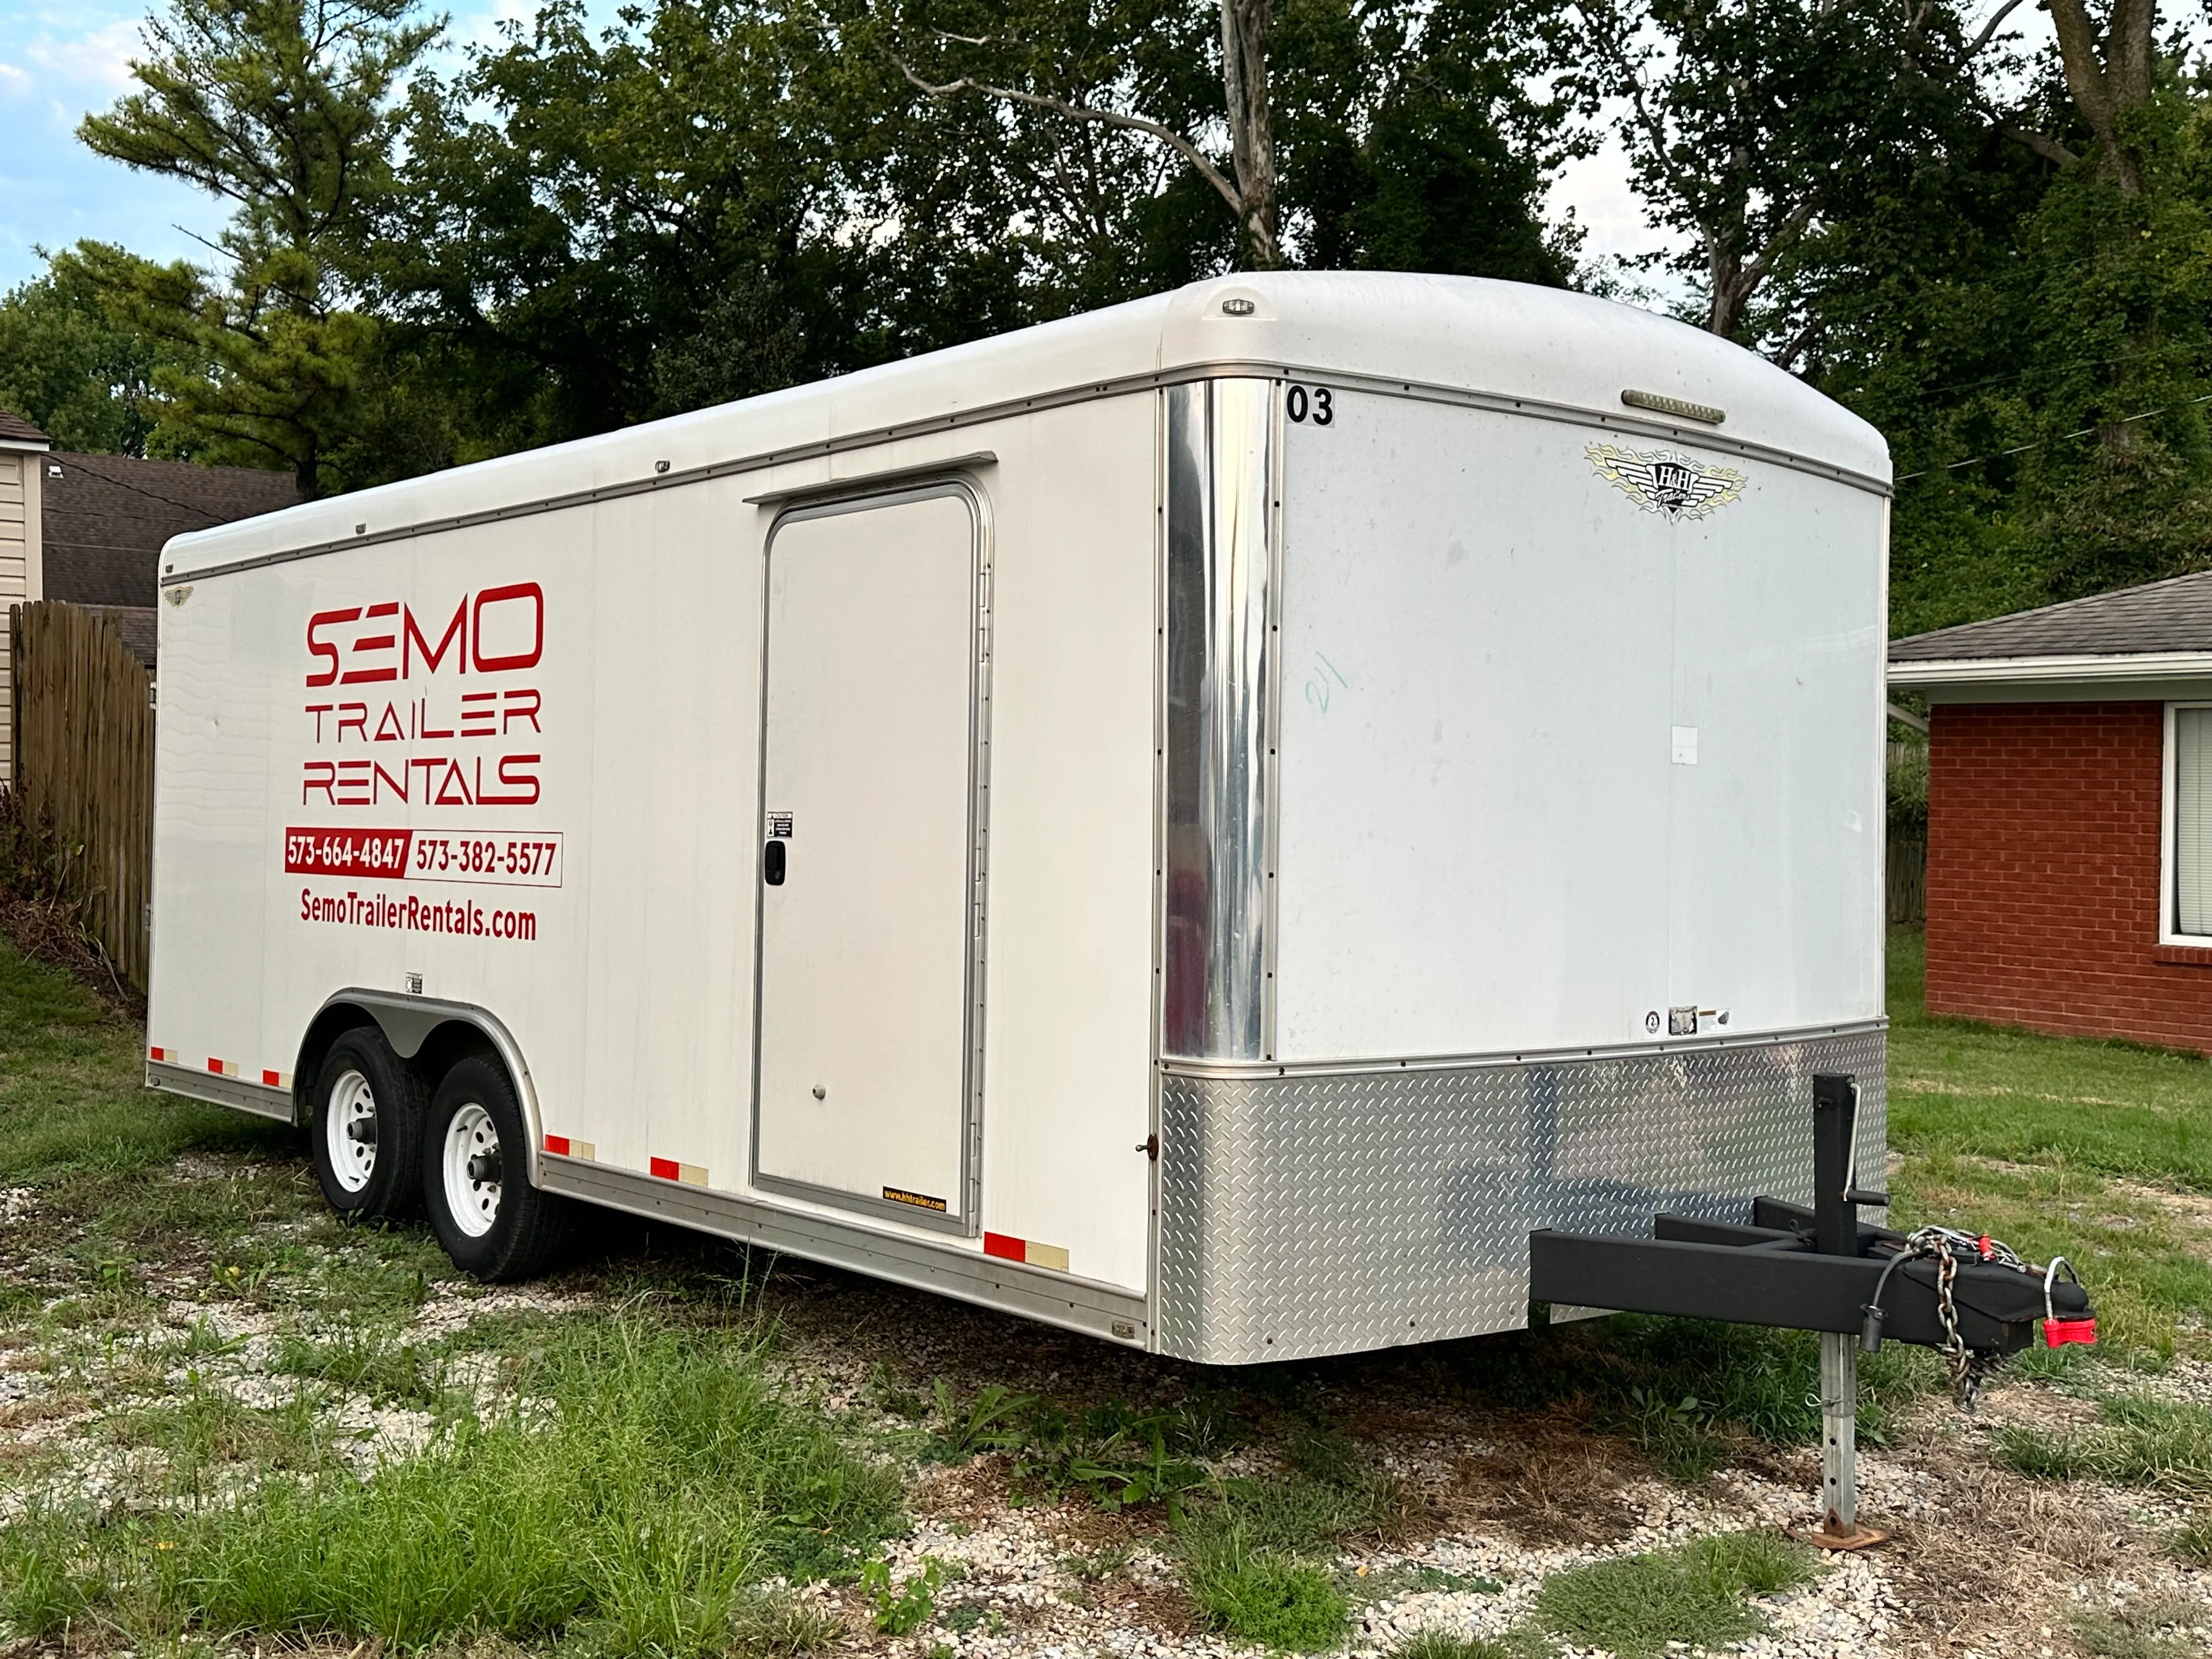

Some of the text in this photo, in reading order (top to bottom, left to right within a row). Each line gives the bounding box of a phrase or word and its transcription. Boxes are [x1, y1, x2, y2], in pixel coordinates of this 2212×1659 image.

[1286, 385, 1333, 426] 03
[1657, 465, 1691, 491] H&H
[306, 582, 544, 687] SEMO
[305, 689, 541, 743] TRAILER
[303, 754, 541, 805] RENTALS
[287, 836, 557, 876] 573-664-4847 573-382-5577
[301, 888, 537, 940] SemoTrailerRentals.com
